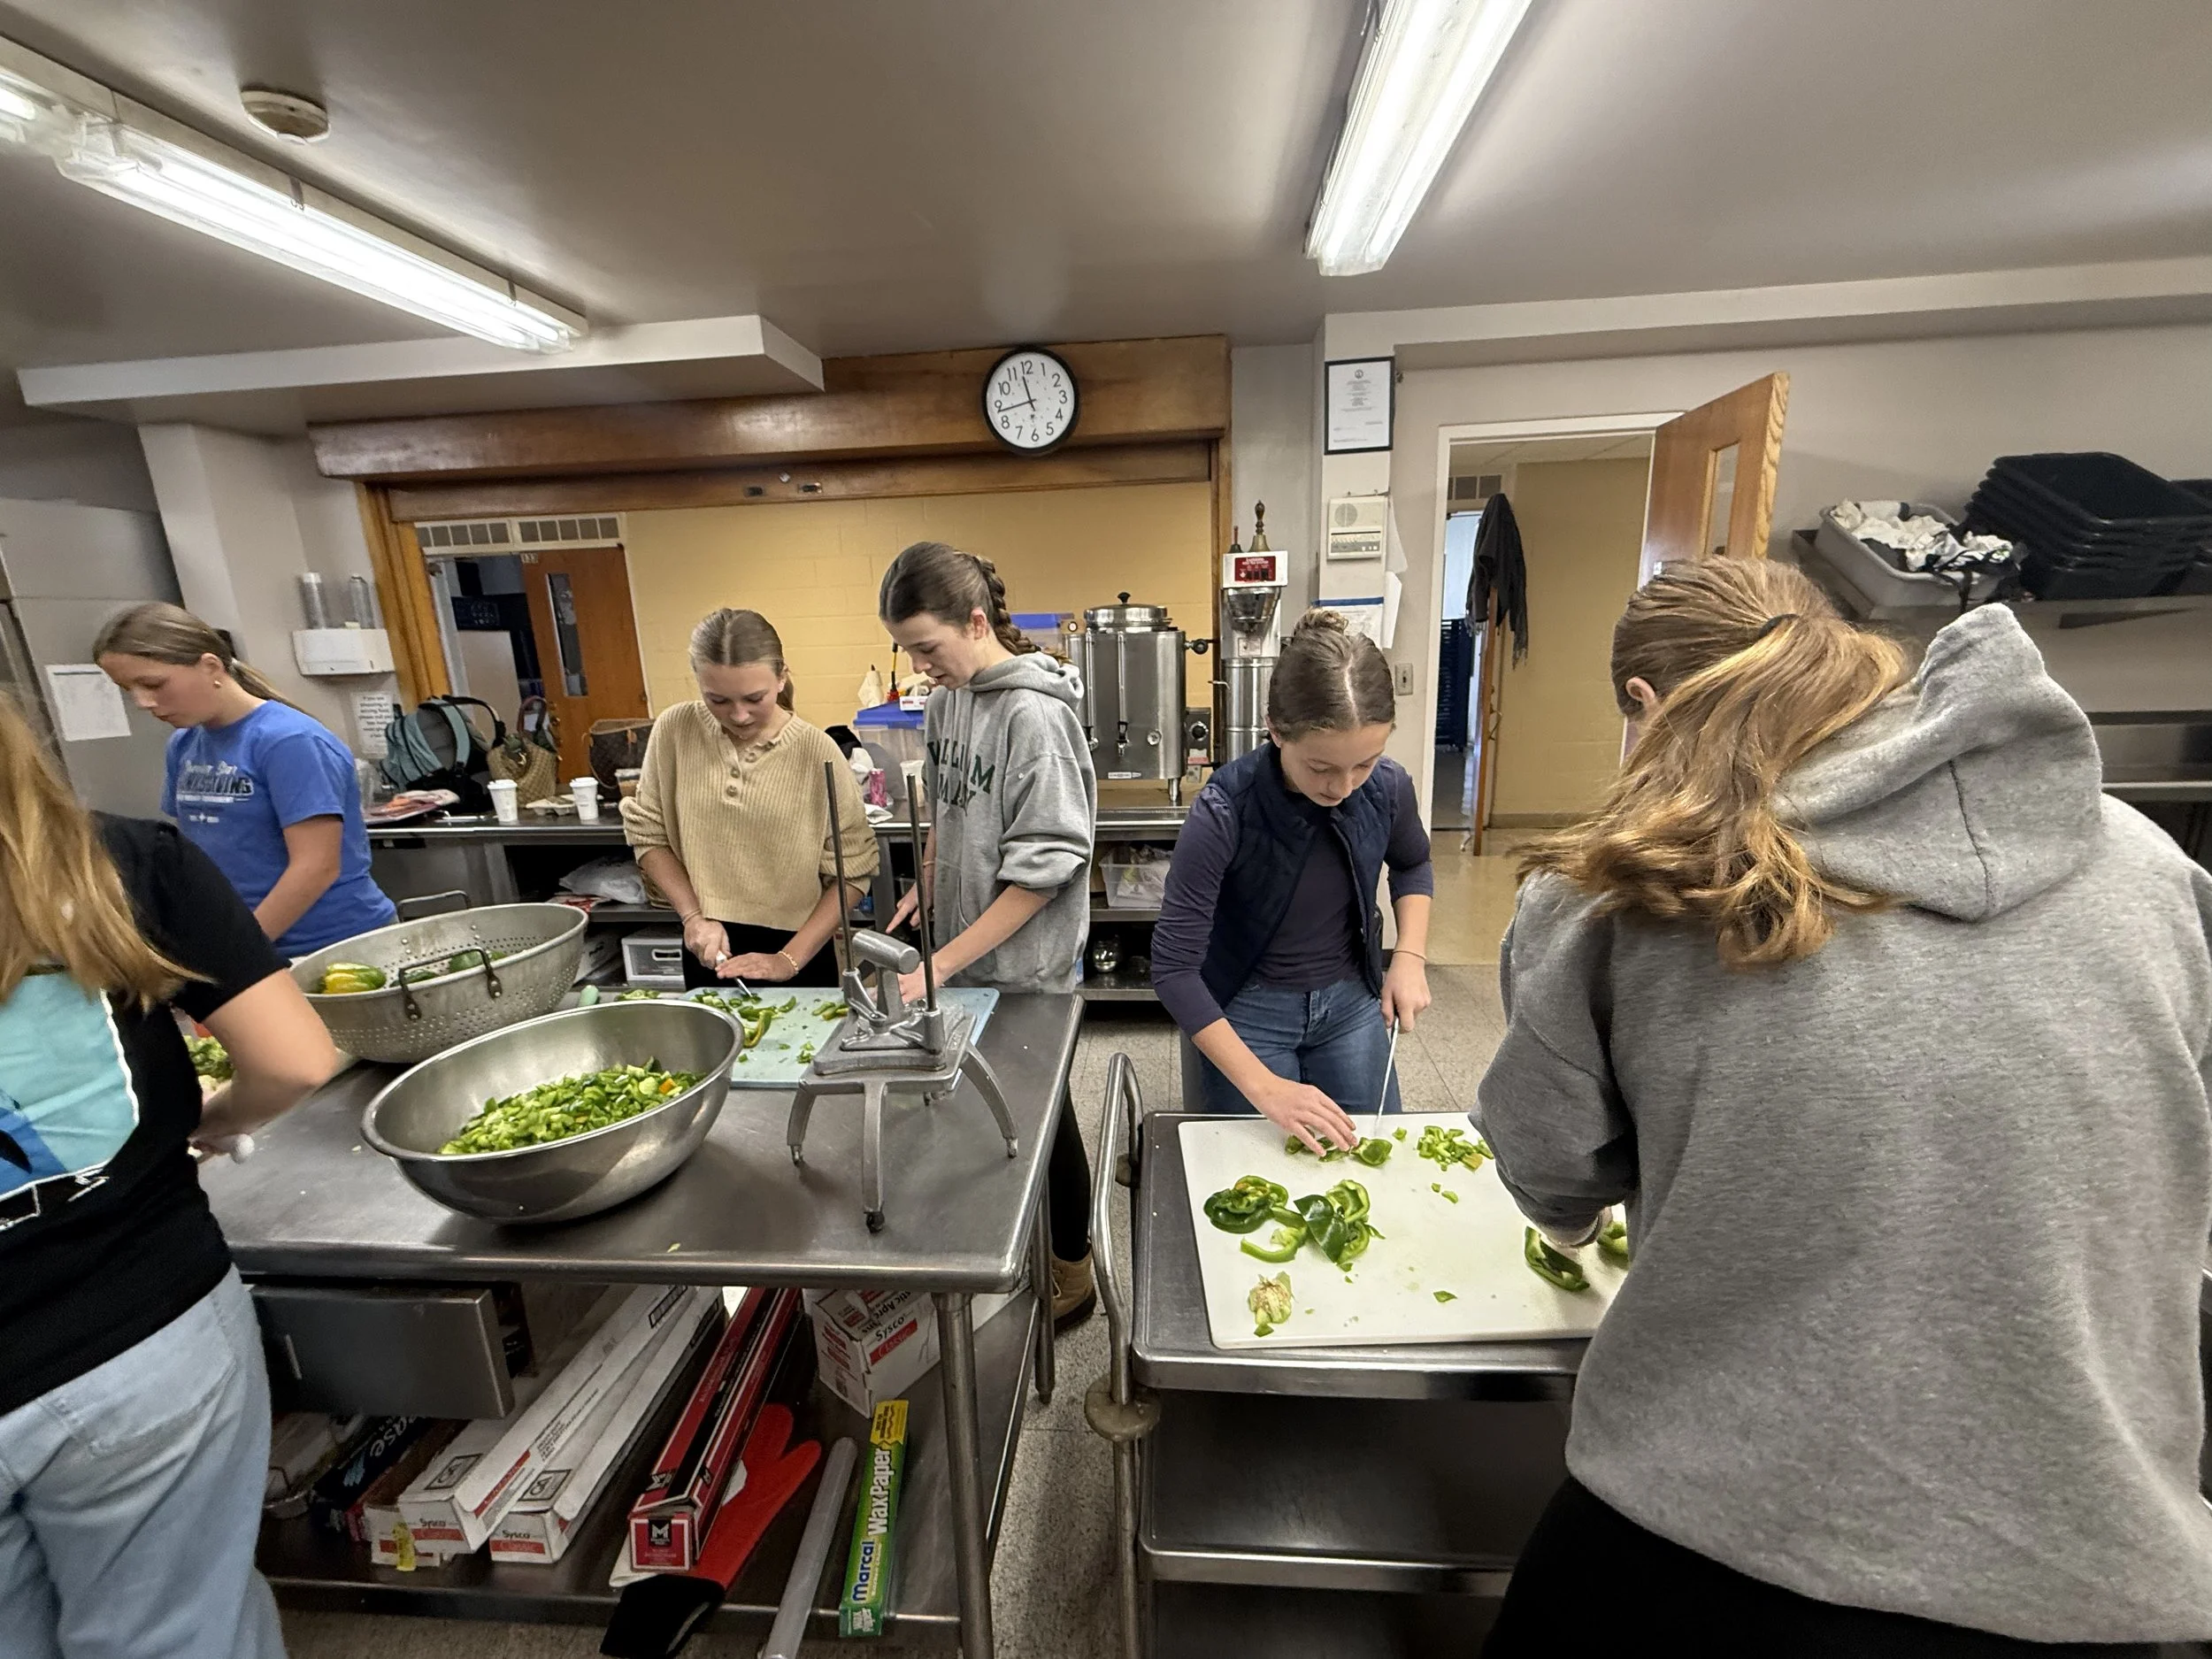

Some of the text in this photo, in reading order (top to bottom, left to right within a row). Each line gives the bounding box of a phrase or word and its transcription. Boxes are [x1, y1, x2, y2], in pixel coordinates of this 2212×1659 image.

[1007, 366, 1018, 381] 11
[1021, 360, 1033, 375] 12
[1041, 363, 1046, 377] 1
[1051, 373, 1061, 388] 2
[998, 380, 1010, 396] 10
[1058, 390, 1067, 404] 3
[995, 400, 1002, 413] 9
[1055, 408, 1063, 421] 4
[1001, 415, 1010, 429] 8
[1045, 422, 1054, 436] 5
[1015, 426, 1023, 440] 7
[1031, 428, 1040, 442] 6
[875, 1316, 904, 1341] Sysco
